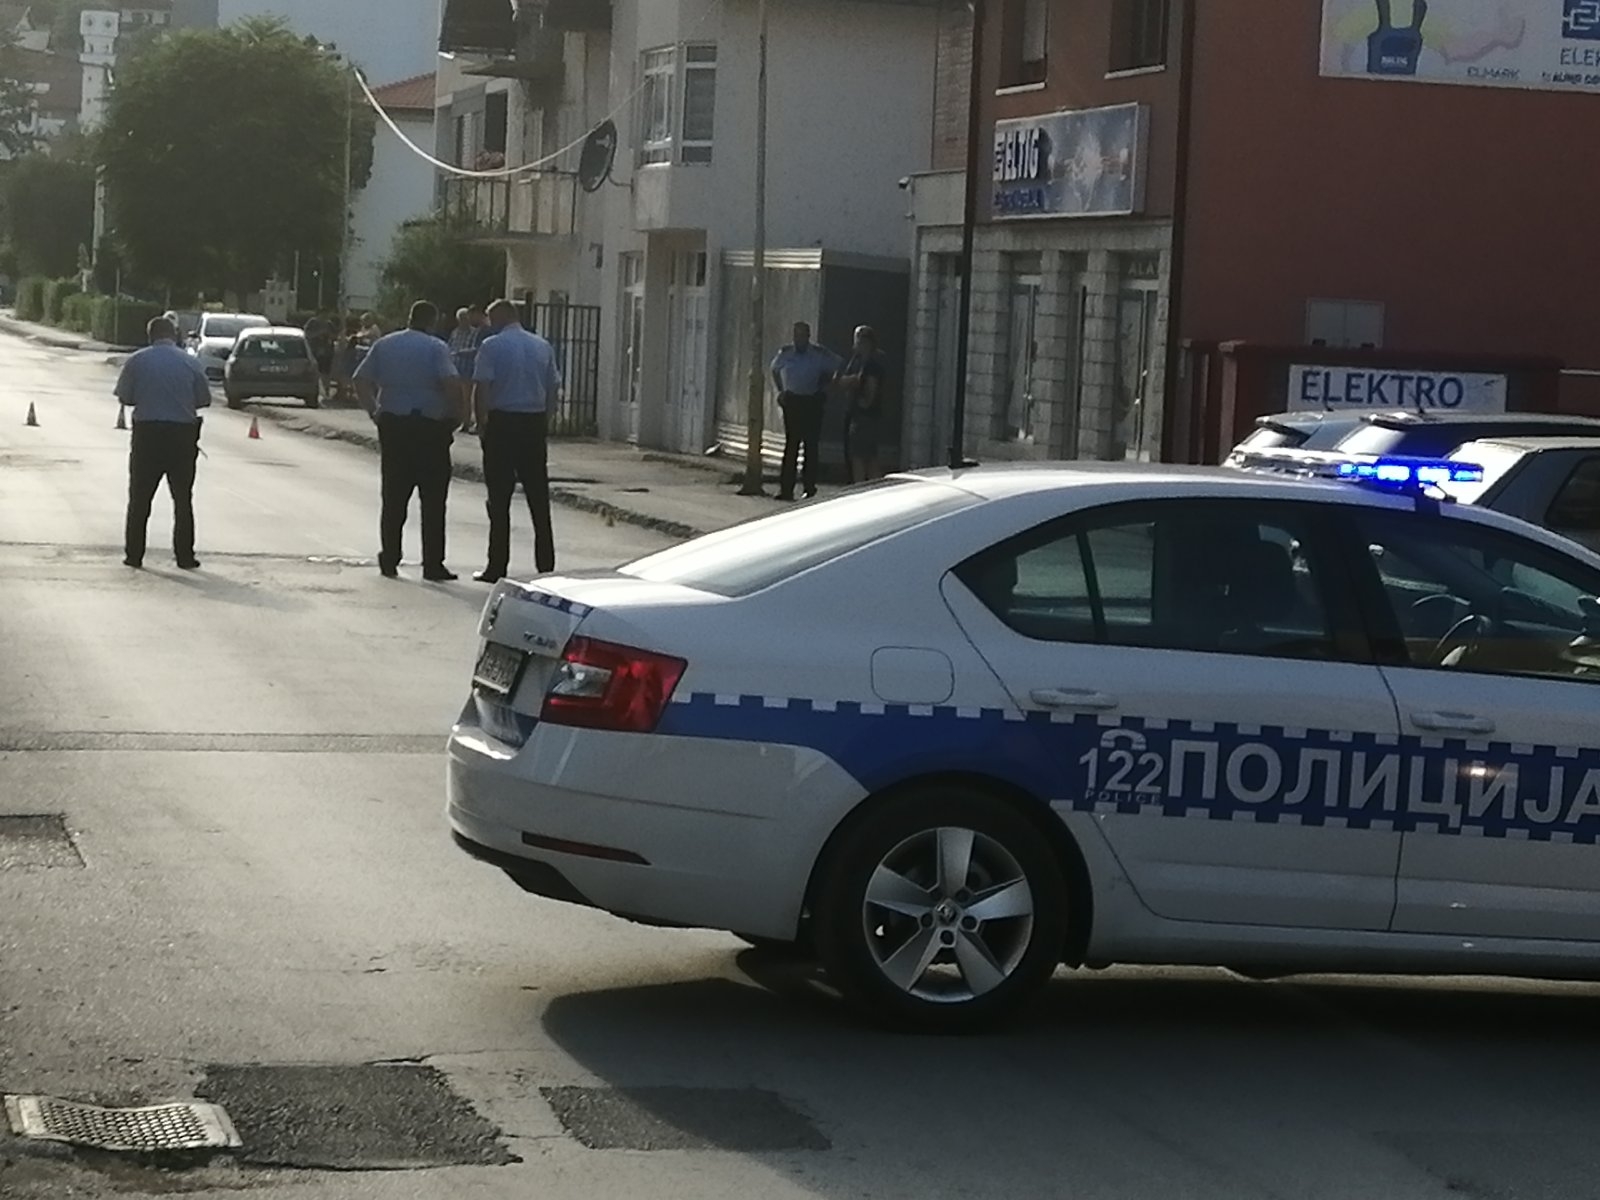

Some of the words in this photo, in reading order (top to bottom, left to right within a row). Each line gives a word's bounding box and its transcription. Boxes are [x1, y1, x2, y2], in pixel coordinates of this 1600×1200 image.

[1301, 370, 1464, 408] ELEKTRO
[1079, 747, 1164, 793] 122
[1168, 739, 1600, 828] ПОЛИЦИЈА
[1085, 788, 1162, 806] POLICE
